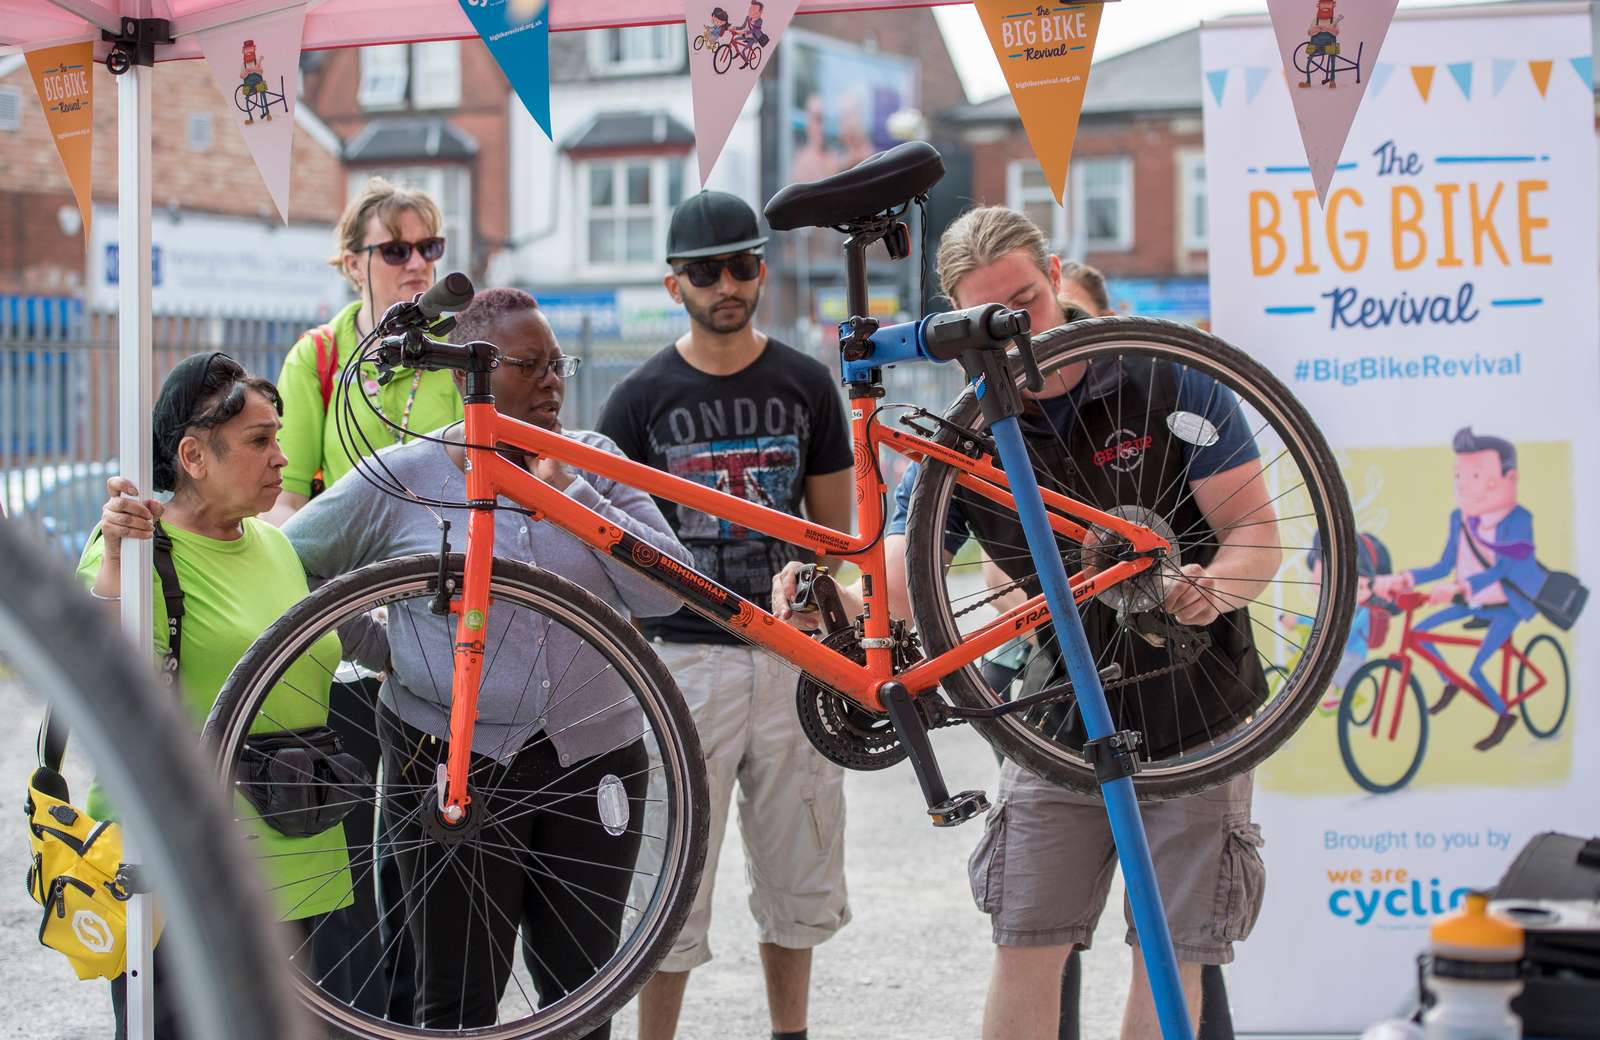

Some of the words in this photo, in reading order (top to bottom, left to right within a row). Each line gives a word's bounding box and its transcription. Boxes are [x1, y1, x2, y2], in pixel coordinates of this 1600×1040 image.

[1036, 5, 1050, 16] The
[1002, 19, 1037, 48] BIG
[1041, 13, 1087, 43] BIKE
[1024, 43, 1067, 61] Revival
[44, 75, 64, 101] BIG
[64, 71, 89, 97] BIKE
[1372, 139, 1424, 178] The
[1248, 186, 1369, 277] BIG
[1390, 179, 1553, 271] BIKE
[1321, 282, 1479, 330] Revival
[1293, 352, 1522, 386] #BigBikeRevival
[646, 397, 810, 455] LONDON
[805, 528, 849, 546] BIRMINGHAM
[660, 555, 728, 600] BIRMINGHAM
[1324, 830, 1409, 854] Brought
[1414, 832, 1436, 849] to
[1442, 833, 1480, 854] you
[1486, 829, 1511, 852] by
[1327, 867, 1363, 884] we
[1371, 865, 1409, 883] are
